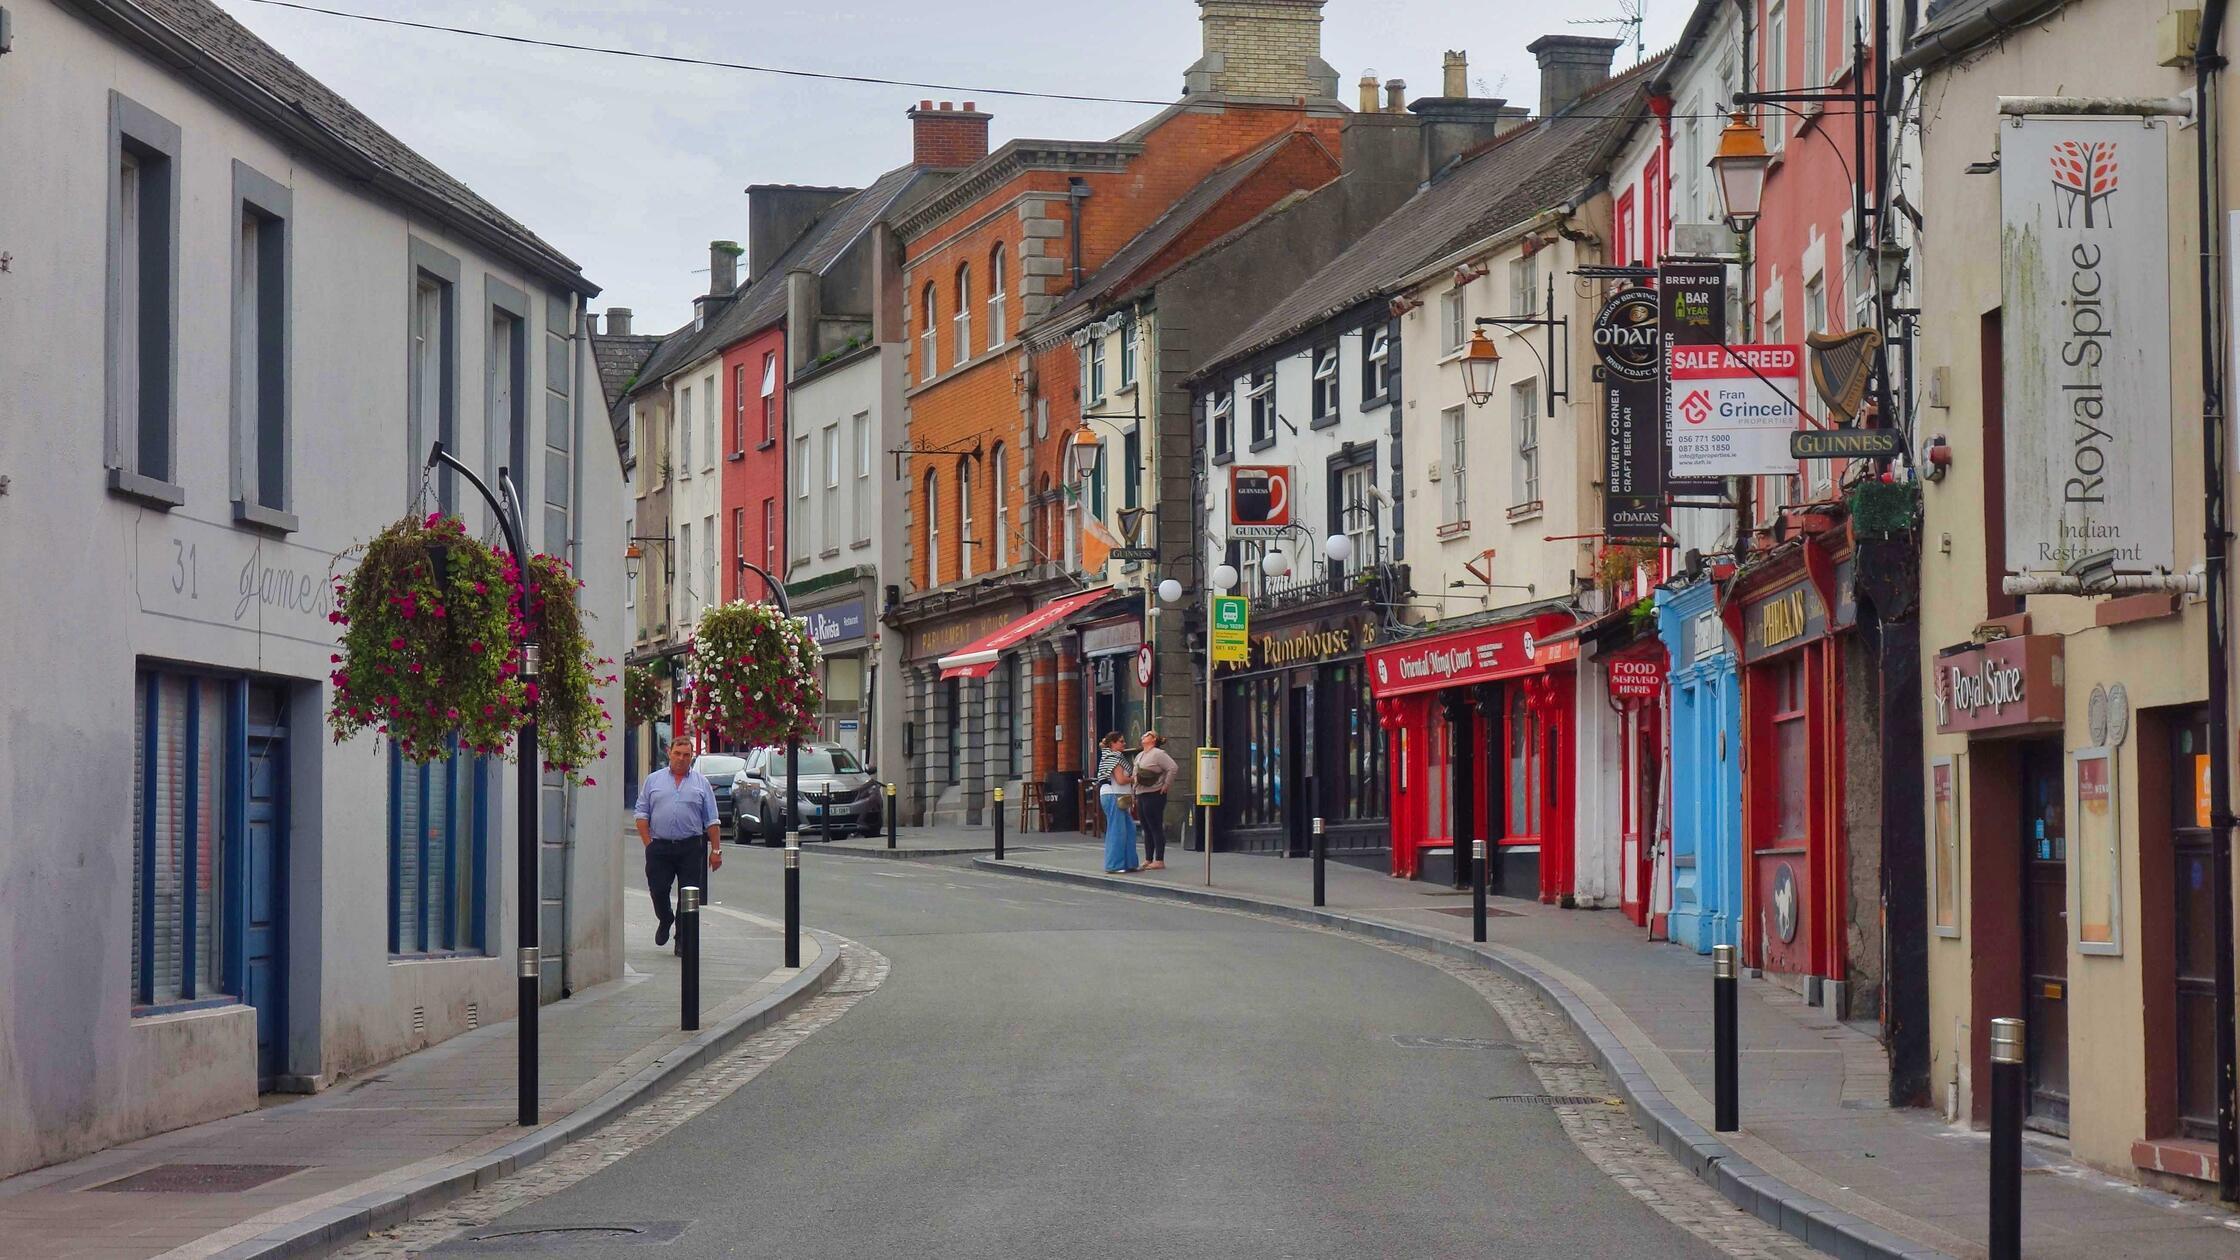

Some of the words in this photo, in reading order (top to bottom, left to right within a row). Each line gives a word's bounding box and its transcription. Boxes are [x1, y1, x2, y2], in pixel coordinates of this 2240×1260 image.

[1665, 276, 1695, 284] BREW
[1699, 276, 1719, 284] PUB
[1620, 292, 1657, 301] BREWING
[1685, 292, 1709, 304] BAR
[2061, 243, 2112, 367] Spice
[1686, 306, 1709, 315] YEAR
[1605, 355, 1624, 372] IRISH
[1674, 351, 1719, 369] SALE
[1723, 350, 1796, 369] AGREED
[1719, 390, 1745, 400] Fran
[1611, 389, 1620, 435] CORNER
[1624, 407, 1632, 428] BAR
[1719, 401, 1794, 417] Grincell
[1738, 418, 1794, 426] PROPERTIES
[1624, 430, 1632, 457] BEER
[1678, 435, 1693, 443] 056
[1694, 435, 1709, 443] 771
[1711, 434, 1731, 442] 5000
[1797, 434, 1893, 453] GUINNESS
[2062, 384, 2113, 503] Royal
[1678, 445, 1693, 453] 087
[1694, 444, 1709, 452] 853
[1711, 444, 1731, 452] 1850
[1611, 439, 1620, 493] BREWERY
[1624, 460, 1632, 493] CRAFT
[1235, 526, 1288, 536] GUINNESS
[2058, 516, 2121, 538] Indian
[1112, 550, 1152, 558] GUINNESS
[171, 538, 198, 599] 31
[922, 623, 971, 652] PARLIAMENT
[1362, 622, 1377, 643] 26
[1400, 650, 1430, 679] Oriental
[1428, 650, 1452, 678] Ming
[1450, 647, 1474, 673] Court
[1614, 662, 1657, 675] FOOD
[1611, 675, 1660, 685] SERVED
[1952, 660, 1985, 718] Royal
[1985, 658, 2021, 715] Spice
[1619, 685, 1652, 694] HERE
